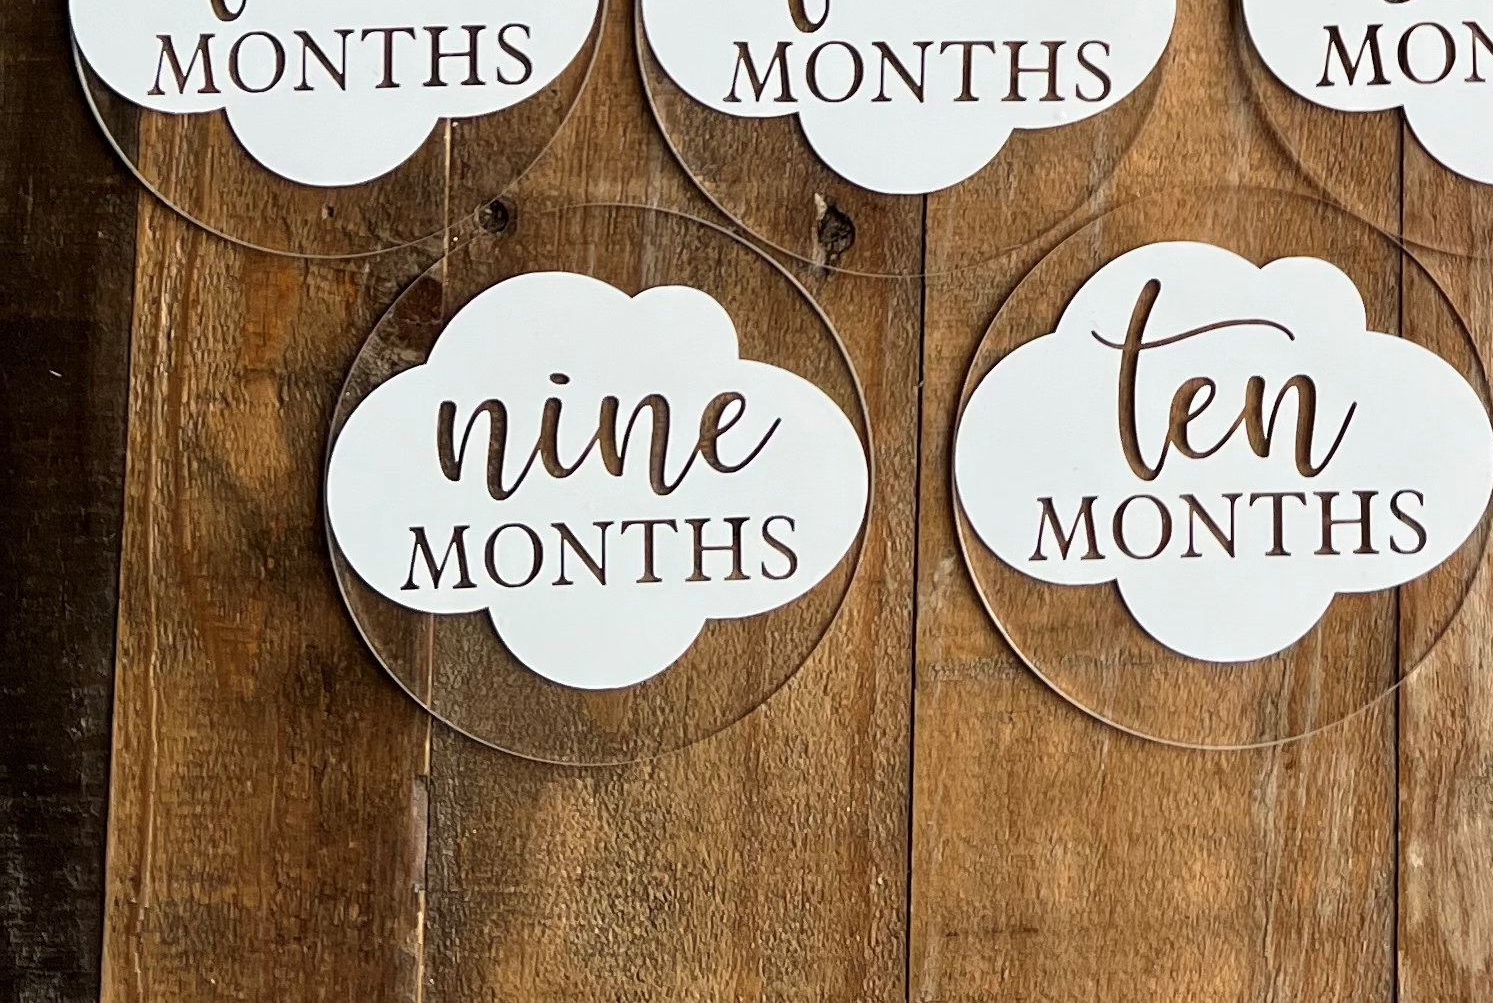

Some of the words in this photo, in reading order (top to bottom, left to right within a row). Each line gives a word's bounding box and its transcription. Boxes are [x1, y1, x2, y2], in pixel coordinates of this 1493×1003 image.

[147, 24, 532, 95] MONTHS
[723, 41, 1111, 103] MONTHS
[1091, 279, 1357, 481] ten
[437, 373, 781, 500] nine
[400, 516, 797, 590] MONTHS
[1029, 490, 1426, 561] MONTHS
